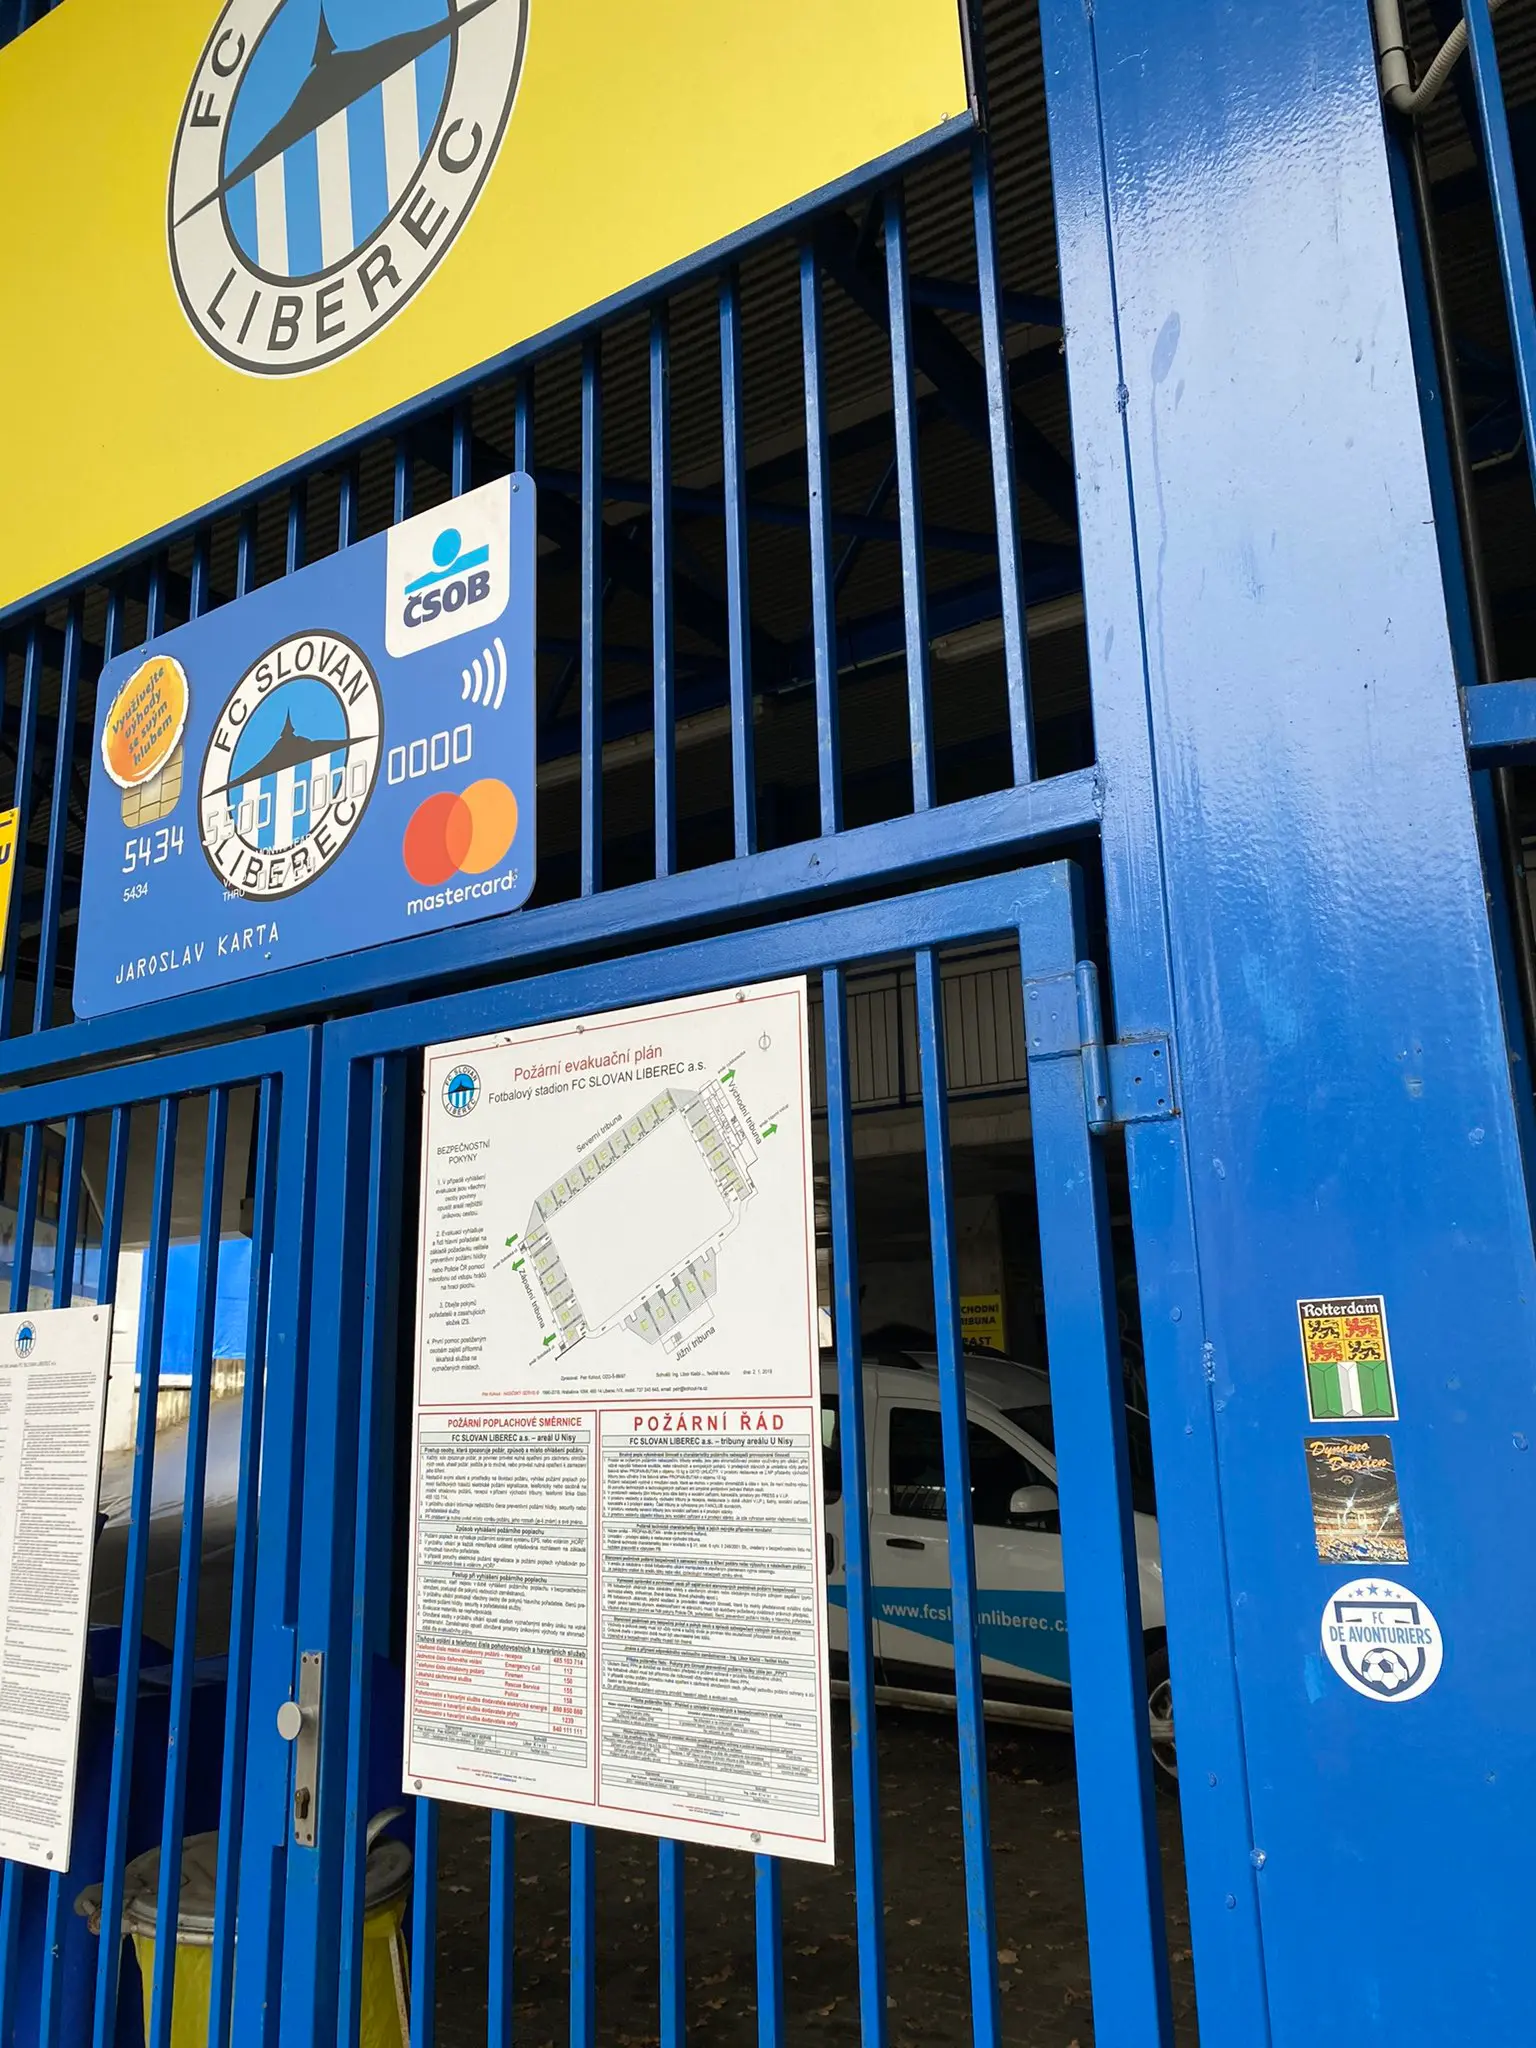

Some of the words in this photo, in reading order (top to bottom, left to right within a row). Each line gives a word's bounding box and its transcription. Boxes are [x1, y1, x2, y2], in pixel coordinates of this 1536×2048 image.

[190, 27, 245, 128] FC
[206, 118, 482, 352] LIBEREC
[403, 570, 490, 629] ČSOB
[214, 698, 247, 752] FC
[255, 641, 369, 706] SLOVAN
[128, 737, 138, 753] se
[122, 825, 184, 873] 5434
[202, 792, 272, 847] 5500
[292, 760, 368, 817] 0000
[387, 723, 472, 785] 0000
[214, 797, 356, 890] LIBEREC
[123, 882, 148, 902] 5434
[407, 870, 513, 916] mastercard
[115, 942, 204, 984] JAROSLAV
[218, 922, 278, 956] KARTA
[514, 1061, 561, 1081] Požární
[565, 1049, 630, 1073] evakuační
[635, 1045, 663, 1063] plán
[454, 1066, 477, 1082] SLOVAN
[489, 1088, 533, 1104] Fotbalový
[535, 1081, 569, 1098] stadion
[572, 1077, 586, 1089] FC
[589, 1070, 633, 1088] SLOVAN
[636, 1061, 685, 1081] LIBEREC
[688, 1060, 706, 1072] a.s.
[446, 1099, 475, 1115] LIBEREC
[728, 1080, 751, 1120] Východní
[745, 1115, 762, 1145] tribuna
[576, 1131, 601, 1153] Severní
[600, 1113, 623, 1135] tribuna
[437, 1139, 490, 1155] BEZPEČNOSTNÍ
[449, 1153, 477, 1164] POKYNY
[519, 1268, 535, 1300] Západní
[531, 1300, 545, 1329] tribuna
[961, 1304, 999, 1313] CHODNÍ
[1301, 1301, 1378, 1317] Rotterdam
[676, 1343, 692, 1361] Jižní
[692, 1326, 715, 1349] tribuna
[448, 1416, 482, 1428] POŽÁRNÍ
[483, 1417, 537, 1427] POPLACHOVÉ
[539, 1415, 582, 1427] SMĚRNICE
[634, 1412, 727, 1431] POŽÁRNÍ
[740, 1411, 784, 1431] ŘÁD
[452, 1434, 460, 1442] FC
[461, 1434, 488, 1442] SLOVAN
[490, 1434, 517, 1442] LIBEREC
[519, 1434, 530, 1442] a.s.
[561, 1434, 576, 1443] Nisy
[630, 1437, 639, 1445] FC
[640, 1437, 668, 1445] SLOVAN
[669, 1437, 700, 1445] LIBEREC
[721, 1437, 745, 1447] tribuny
[747, 1437, 769, 1445] areálu
[770, 1437, 775, 1445] U
[778, 1437, 793, 1447] Nisy
[1310, 1441, 1370, 1458] Dynamo
[456, 1525, 473, 1533] Způsob
[474, 1526, 498, 1534] vyhlášení
[499, 1527, 520, 1535] požárního
[452, 1571, 468, 1580] Postup
[476, 1572, 498, 1580] vyhlášení
[500, 1574, 523, 1582] požárního
[524, 1576, 547, 1584] poplachu
[1372, 1612, 1384, 1624] FC
[1329, 1626, 1346, 1642] DE
[1349, 1626, 1432, 1644] AVONTURIERS
[491, 1642, 531, 1651] pohotovostních
[567, 1649, 585, 1657] služeb
[505, 1662, 531, 1671] Emergency
